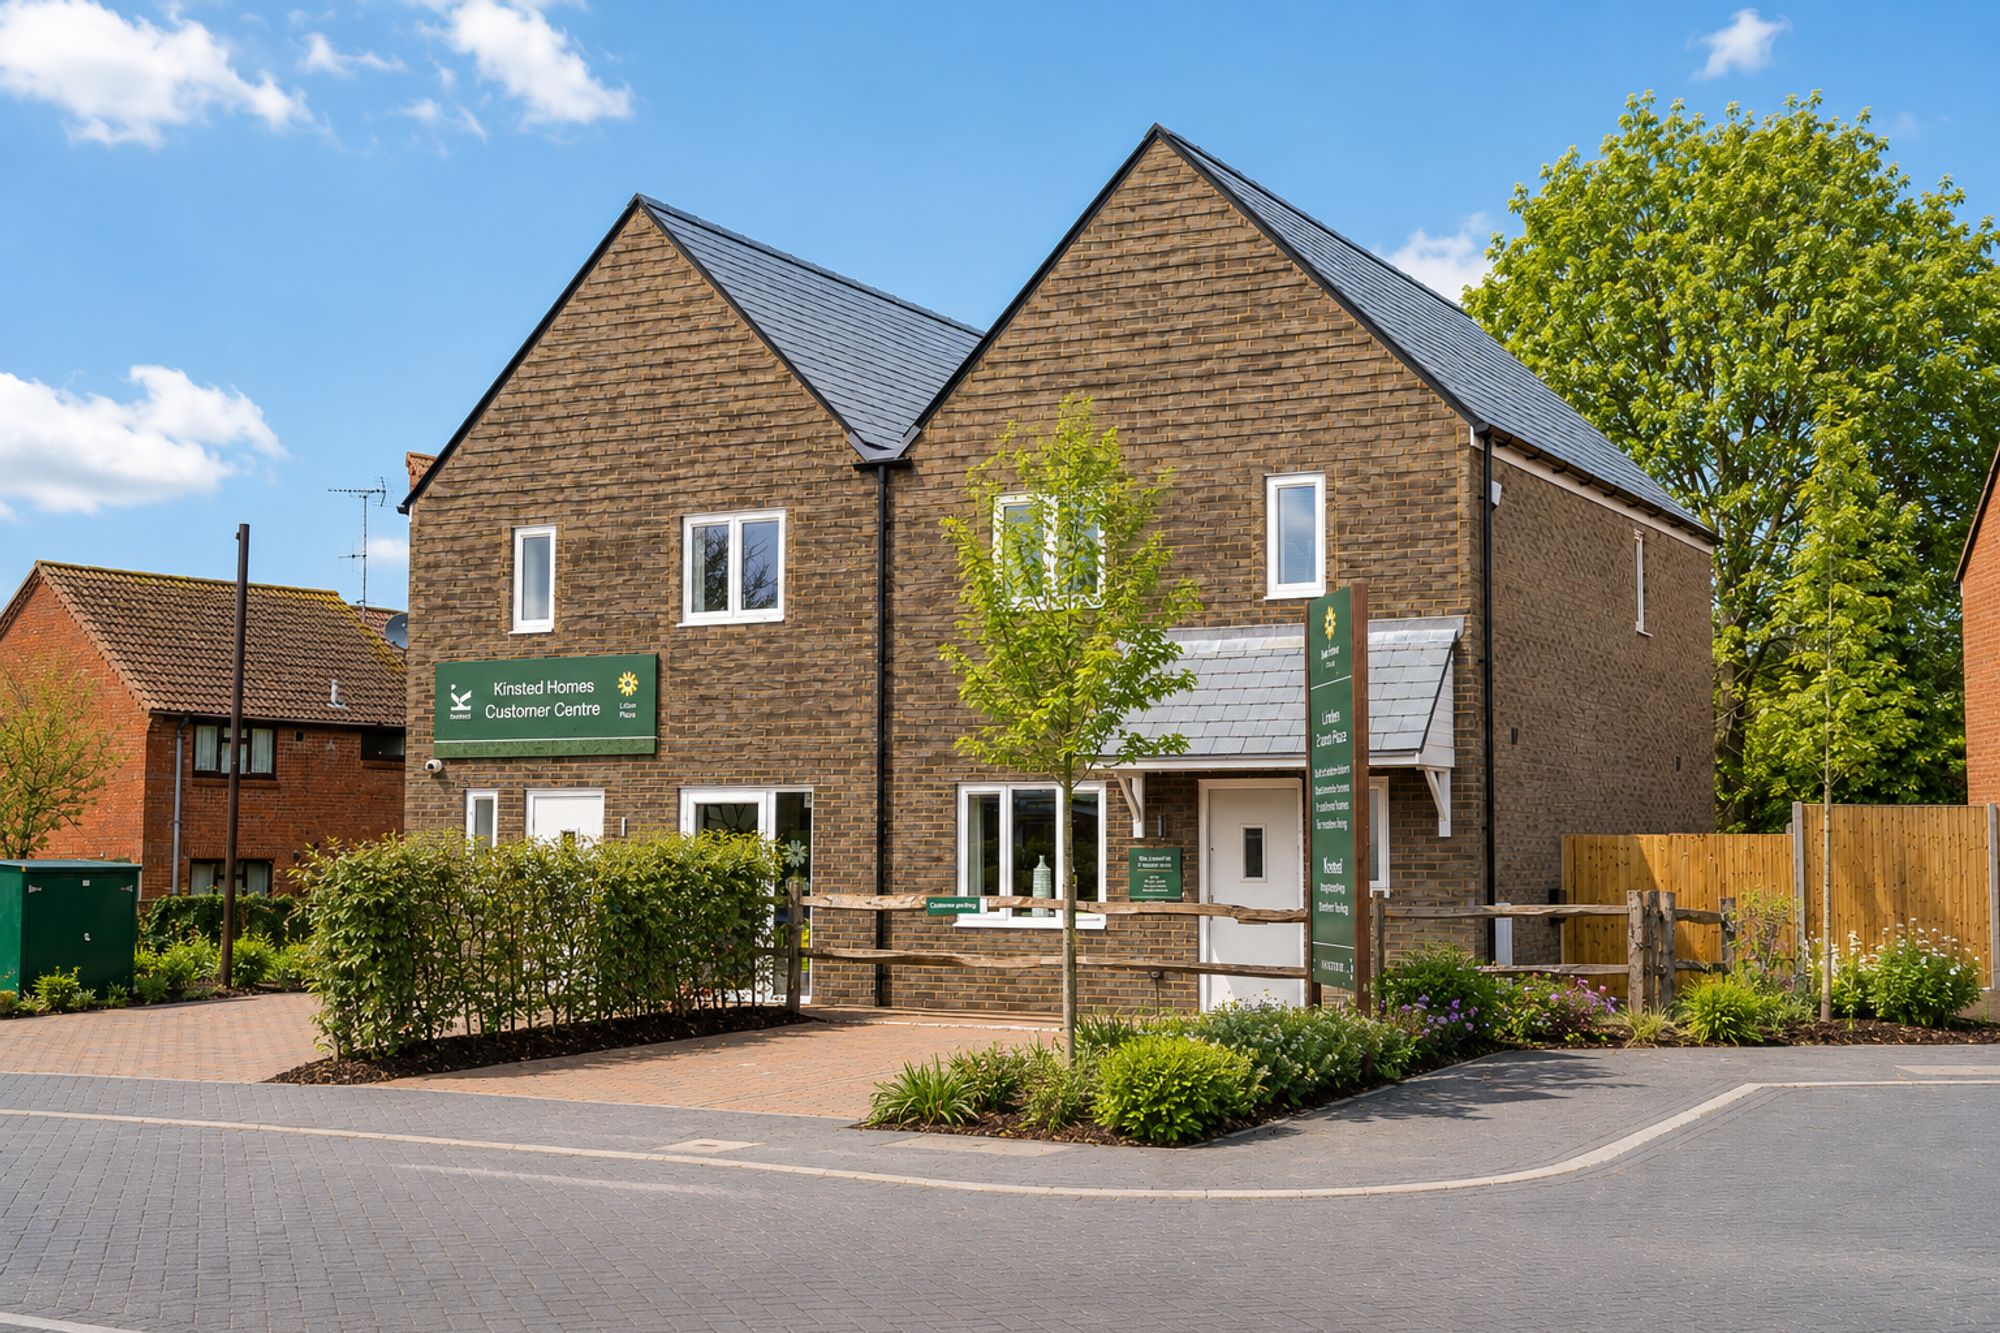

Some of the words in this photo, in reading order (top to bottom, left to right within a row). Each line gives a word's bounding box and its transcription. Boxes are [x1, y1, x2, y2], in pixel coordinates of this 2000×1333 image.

[494, 680, 543, 696] Kinsted
[547, 680, 595, 694] Homes
[485, 703, 550, 719] Customer
[554, 702, 601, 718] Centre
